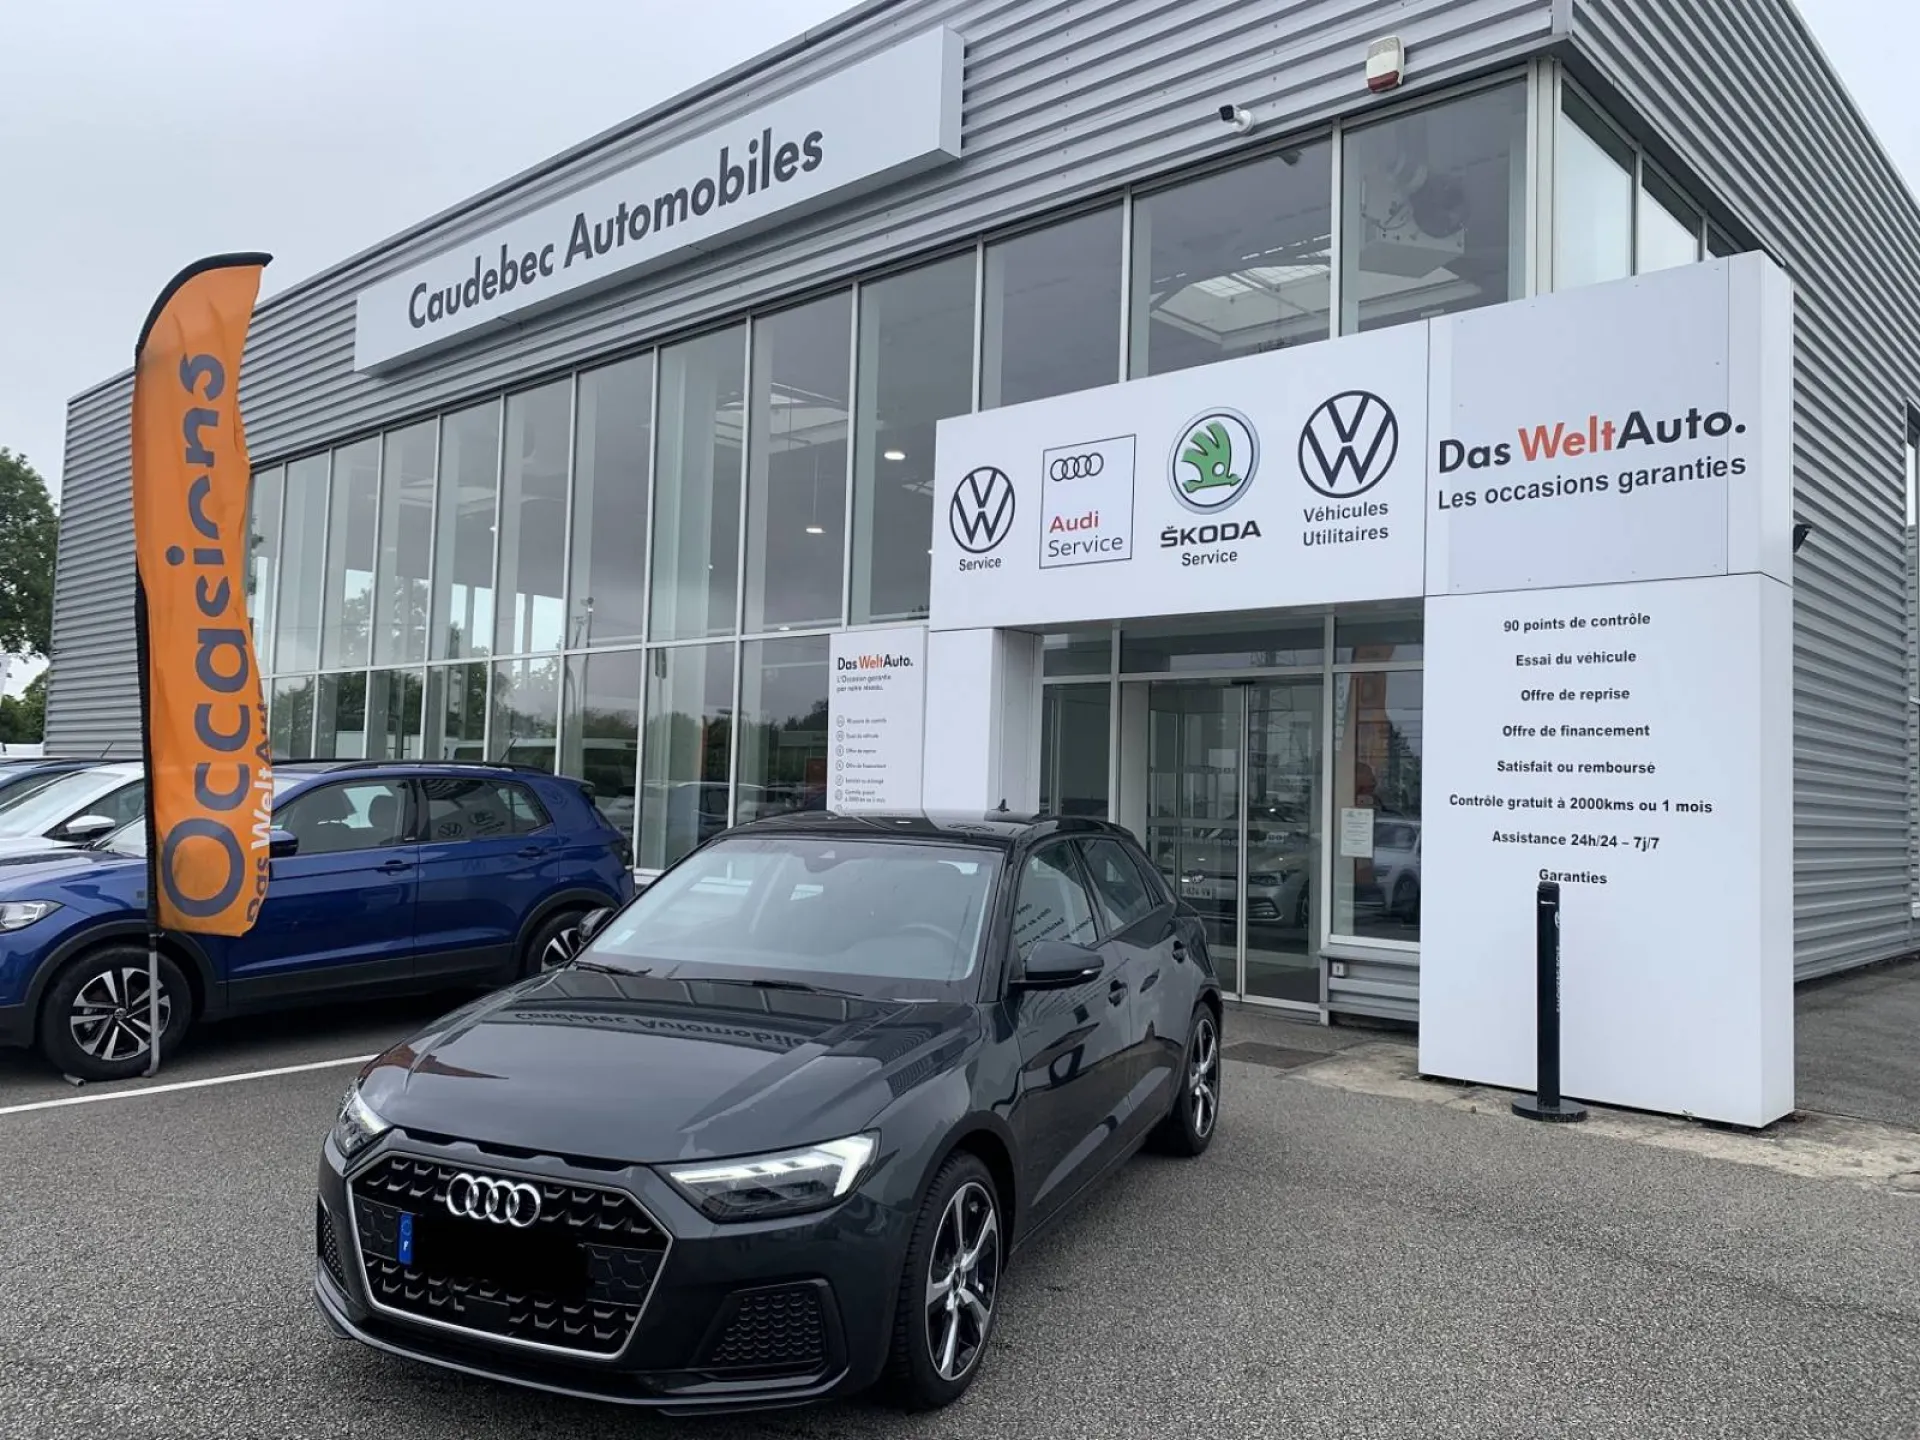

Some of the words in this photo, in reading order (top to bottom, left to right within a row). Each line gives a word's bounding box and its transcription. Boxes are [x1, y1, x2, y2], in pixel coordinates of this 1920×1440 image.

[409, 244, 554, 328] Caudebec
[563, 127, 824, 268] Automobiles
[1440, 439, 1510, 473] Das
[1439, 491, 1476, 509] Les
[1485, 475, 1608, 503] occasions
[1619, 456, 1745, 493] garanties
[1050, 511, 1098, 533] Audi
[1304, 502, 1388, 522] Véhicules
[1161, 521, 1261, 548] ŠKODA
[1304, 526, 1388, 546] Utilitaires
[1048, 536, 1123, 557] Service
[959, 557, 1001, 571] Service
[1182, 550, 1237, 566] Service
[1503, 619, 1520, 633] 90
[1523, 618, 1566, 634] points
[1569, 616, 1587, 629] de
[1592, 612, 1651, 627] contrôle
[838, 657, 858, 671] Das
[1516, 653, 1552, 667] Essai
[1555, 652, 1573, 665] du
[1520, 689, 1555, 702] Offre
[1558, 688, 1576, 701] de
[1579, 687, 1631, 703] reprise
[1502, 725, 1536, 737] Offre
[1539, 725, 1557, 737] de
[1560, 724, 1650, 737] financement
[1496, 760, 1553, 773] Satisfait
[1556, 763, 1574, 773] ou
[1449, 793, 1504, 808] Contrôle
[1507, 797, 1553, 811] gratuit
[1556, 796, 1566, 809] à
[1570, 797, 1634, 811] 2000kms
[1638, 802, 1657, 812] ou
[1662, 799, 1669, 812] 1
[1675, 800, 1713, 814] mois
[1492, 830, 1567, 846] Assistance
[1570, 833, 1618, 848] 24h/24
[1538, 868, 1608, 885] Garanties
